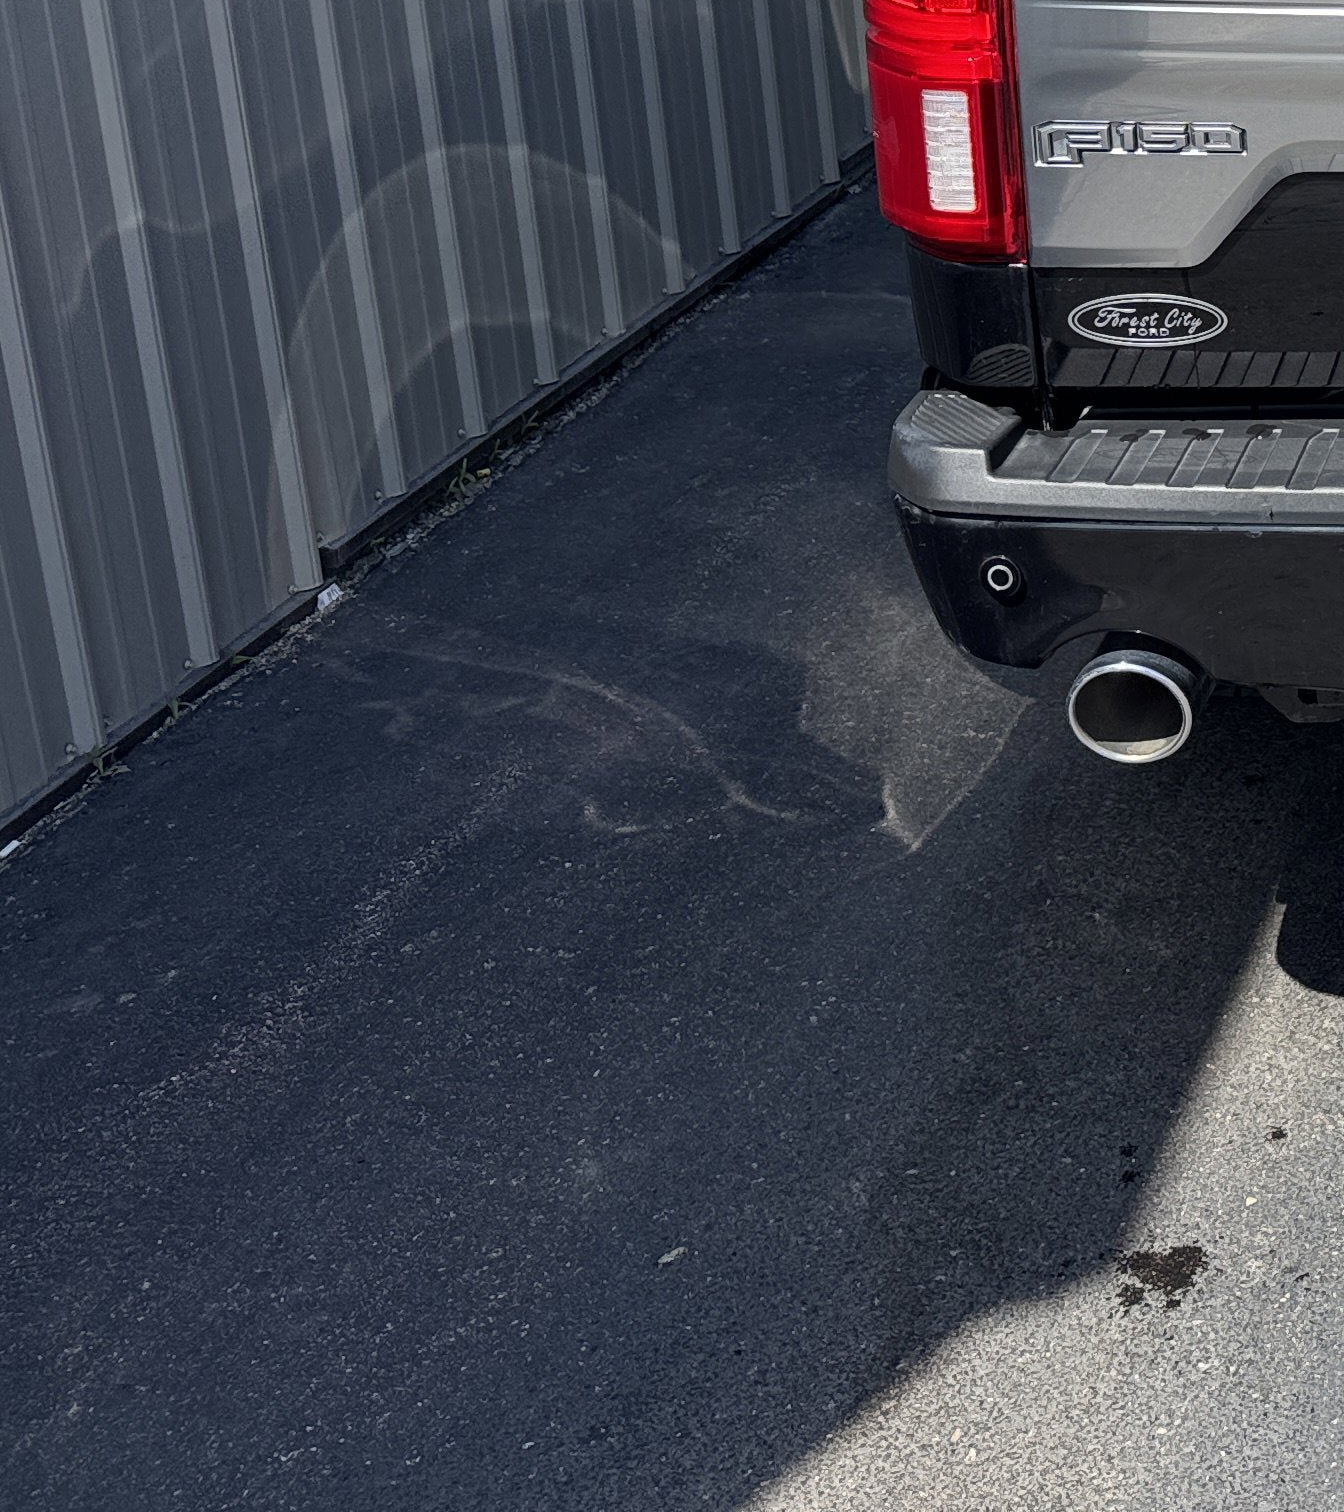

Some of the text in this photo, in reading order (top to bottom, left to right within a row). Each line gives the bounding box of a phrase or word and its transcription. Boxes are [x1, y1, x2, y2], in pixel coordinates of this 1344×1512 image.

[1094, 307, 1202, 334] Forest City
[1128, 328, 1170, 337] FORD
